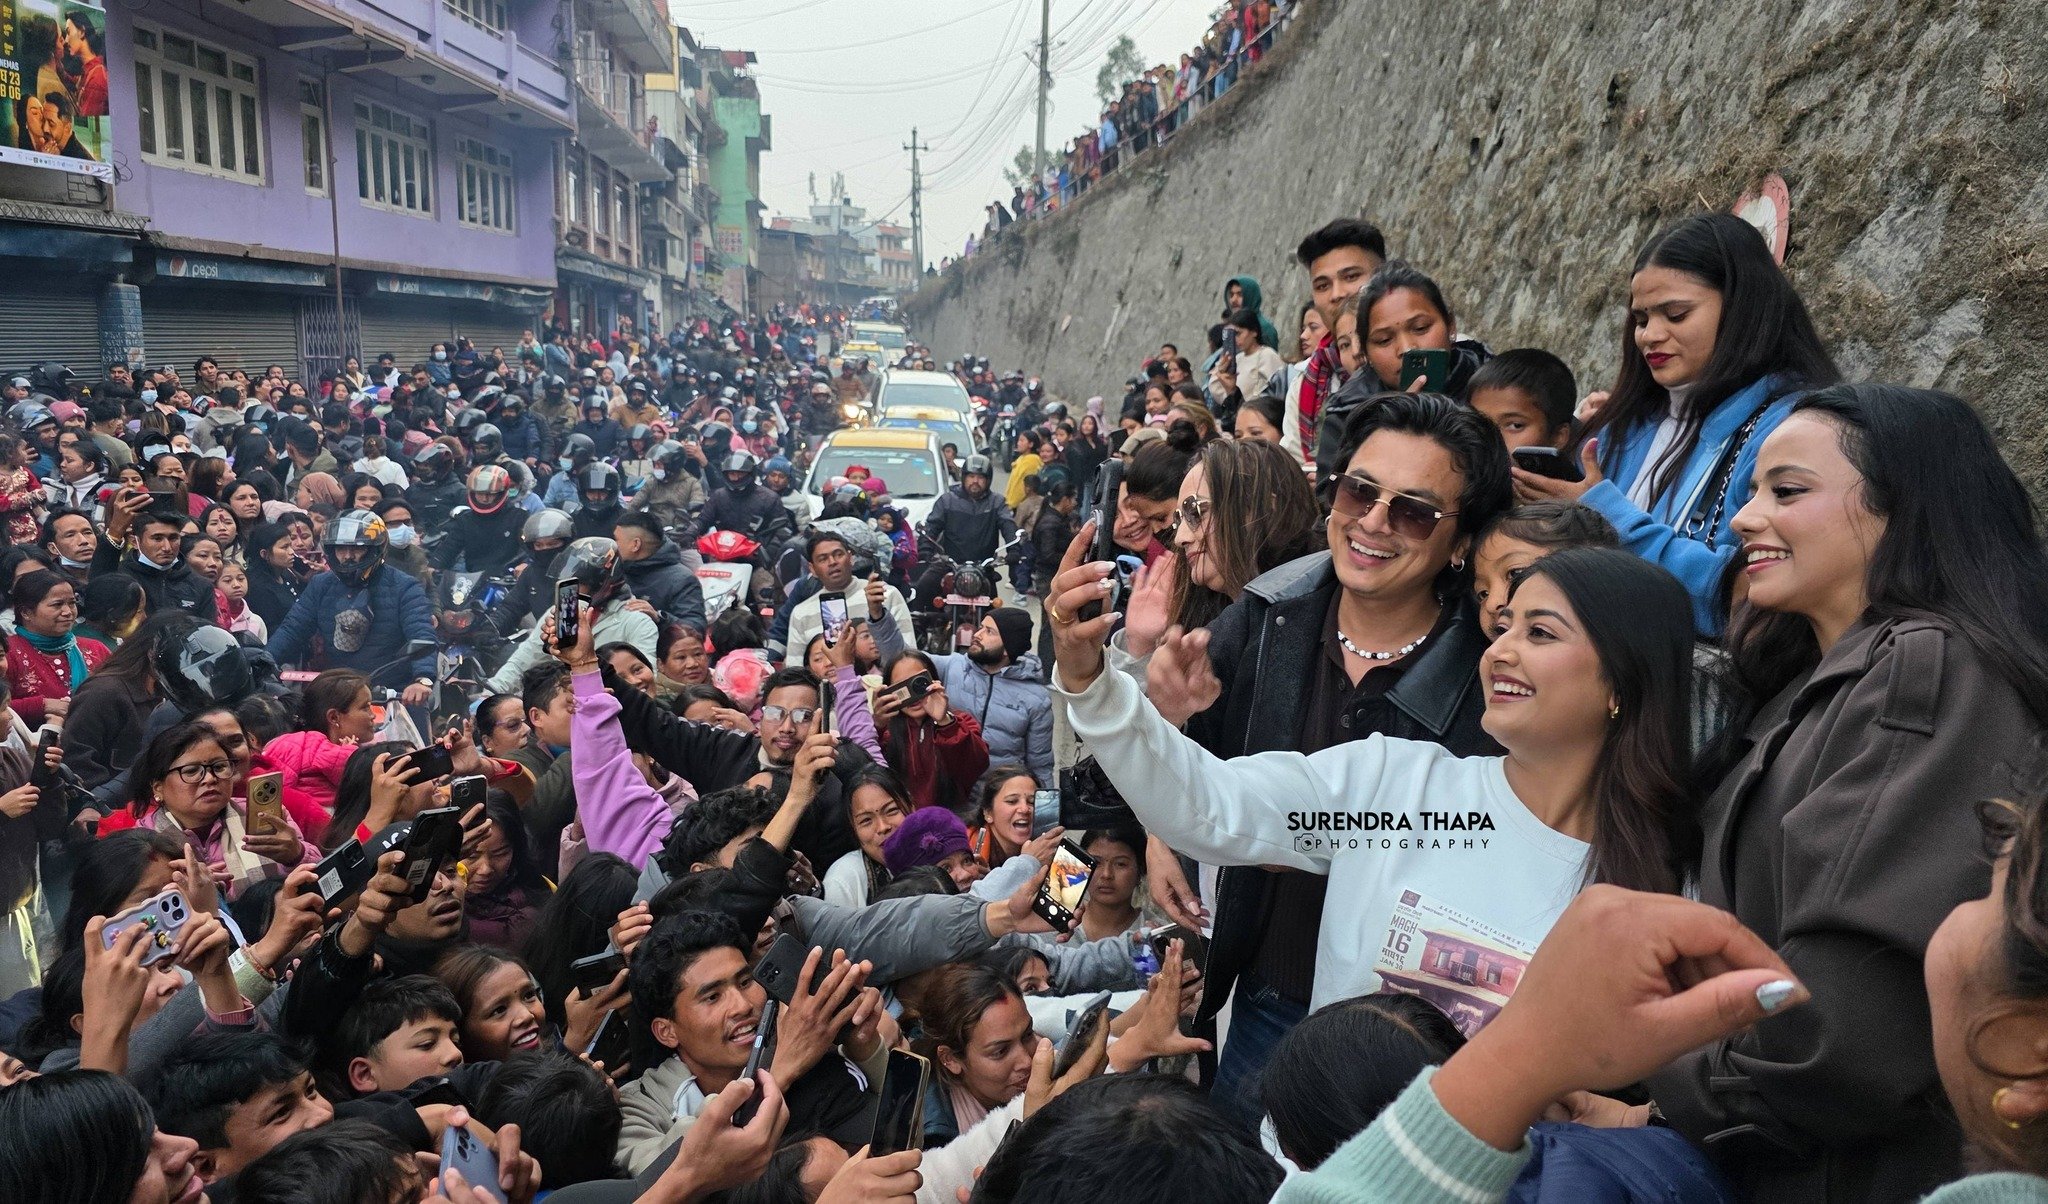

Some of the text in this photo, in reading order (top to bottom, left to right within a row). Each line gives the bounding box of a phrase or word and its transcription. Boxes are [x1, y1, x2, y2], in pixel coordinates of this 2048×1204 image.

[0, 58, 19, 71] NEMAS
[9, 70, 20, 86] 23
[9, 85, 21, 100] 06
[192, 262, 219, 279] pepsi
[1390, 914, 1419, 935] MAGH
[1387, 928, 1412, 954] 16
[1379, 956, 1404, 972] JAN 30
